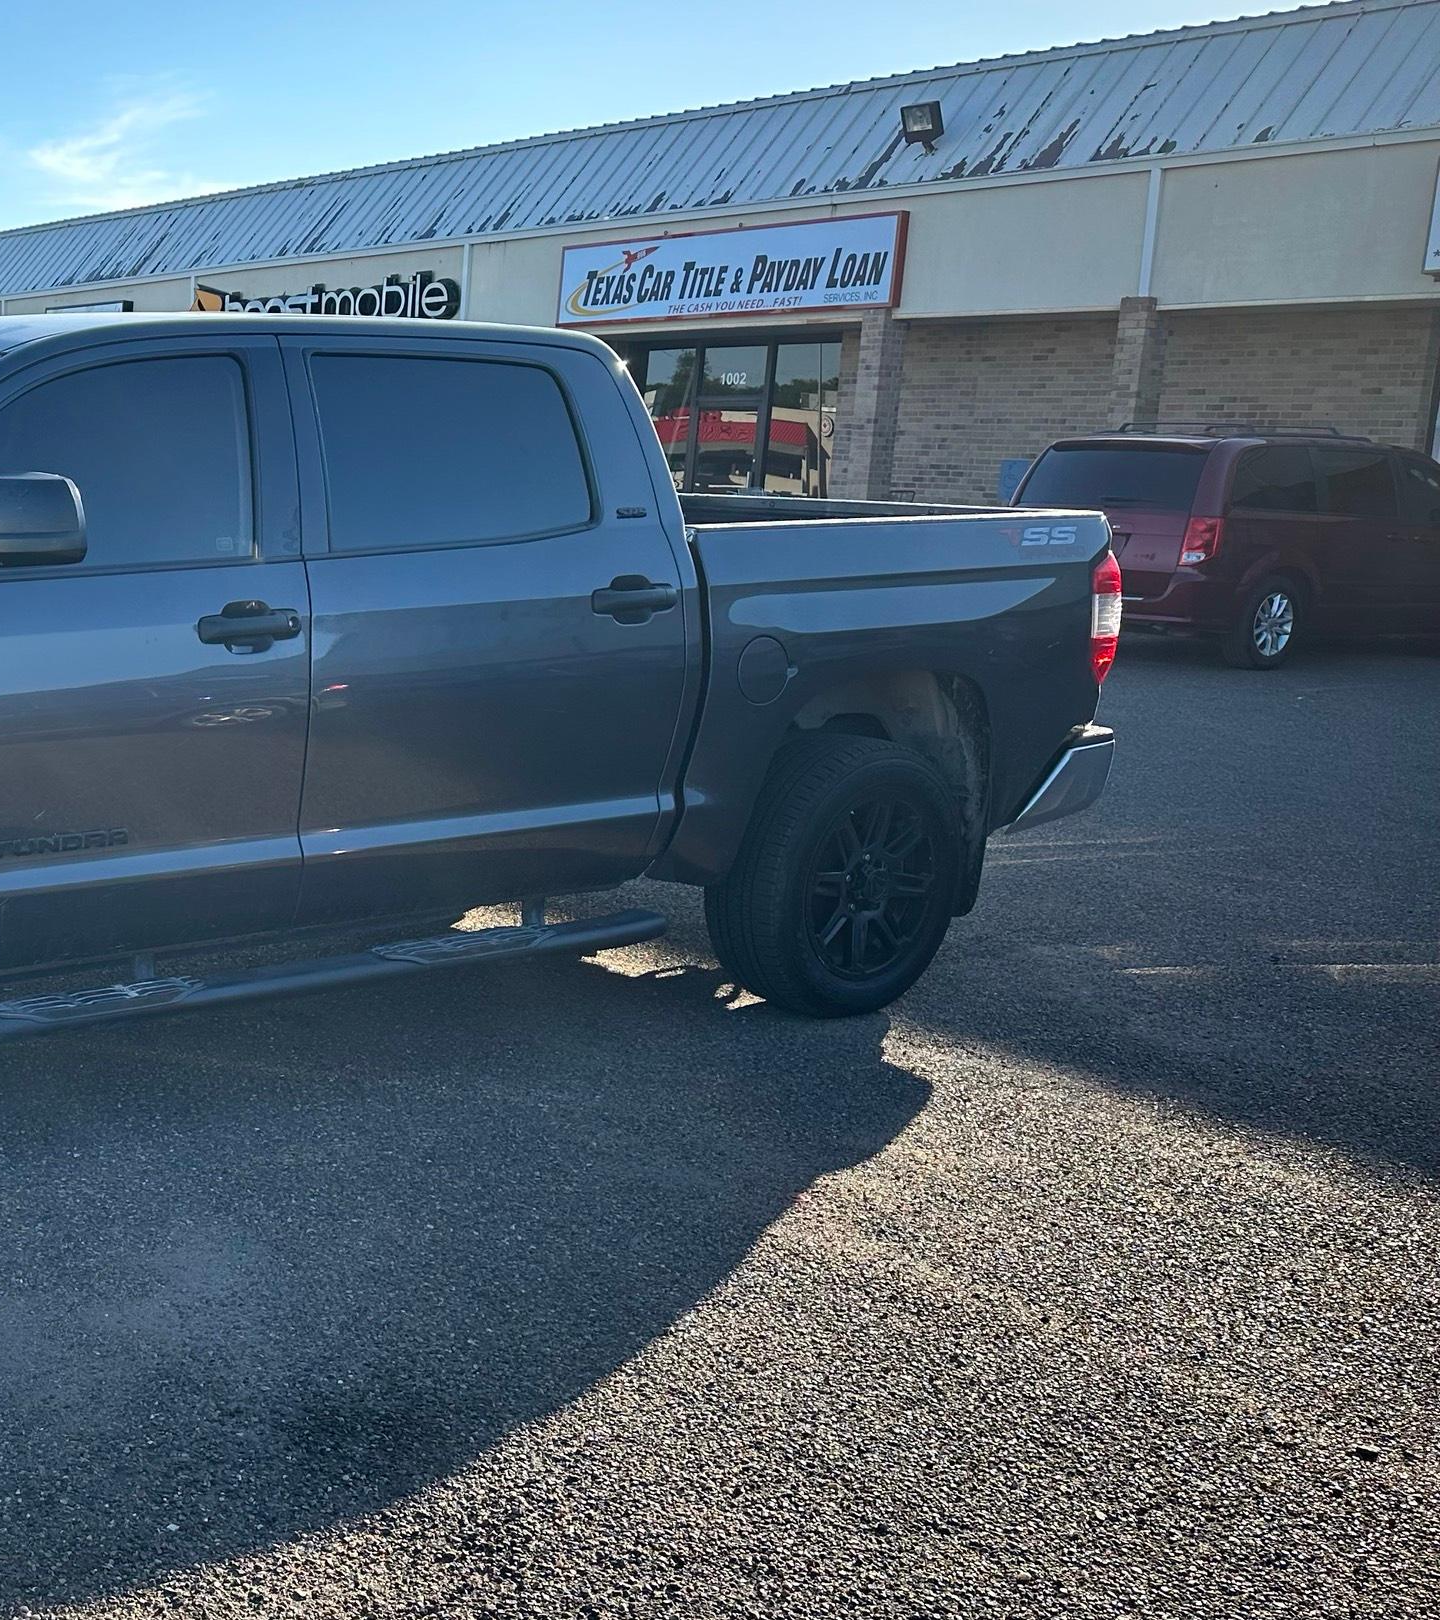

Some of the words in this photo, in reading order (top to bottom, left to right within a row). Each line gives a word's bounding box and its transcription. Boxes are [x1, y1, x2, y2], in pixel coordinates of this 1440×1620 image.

[582, 270, 636, 307] TEXAS
[637, 264, 675, 303] CAR
[678, 261, 728, 299] TITLE
[730, 267, 743, 294] &
[746, 254, 826, 294] PAYDAY
[826, 248, 889, 289] LOAN
[667, 304, 686, 314] THE
[687, 302, 712, 313] CASH
[714, 300, 735, 311] YOU
[720, 372, 747, 385] 1002
